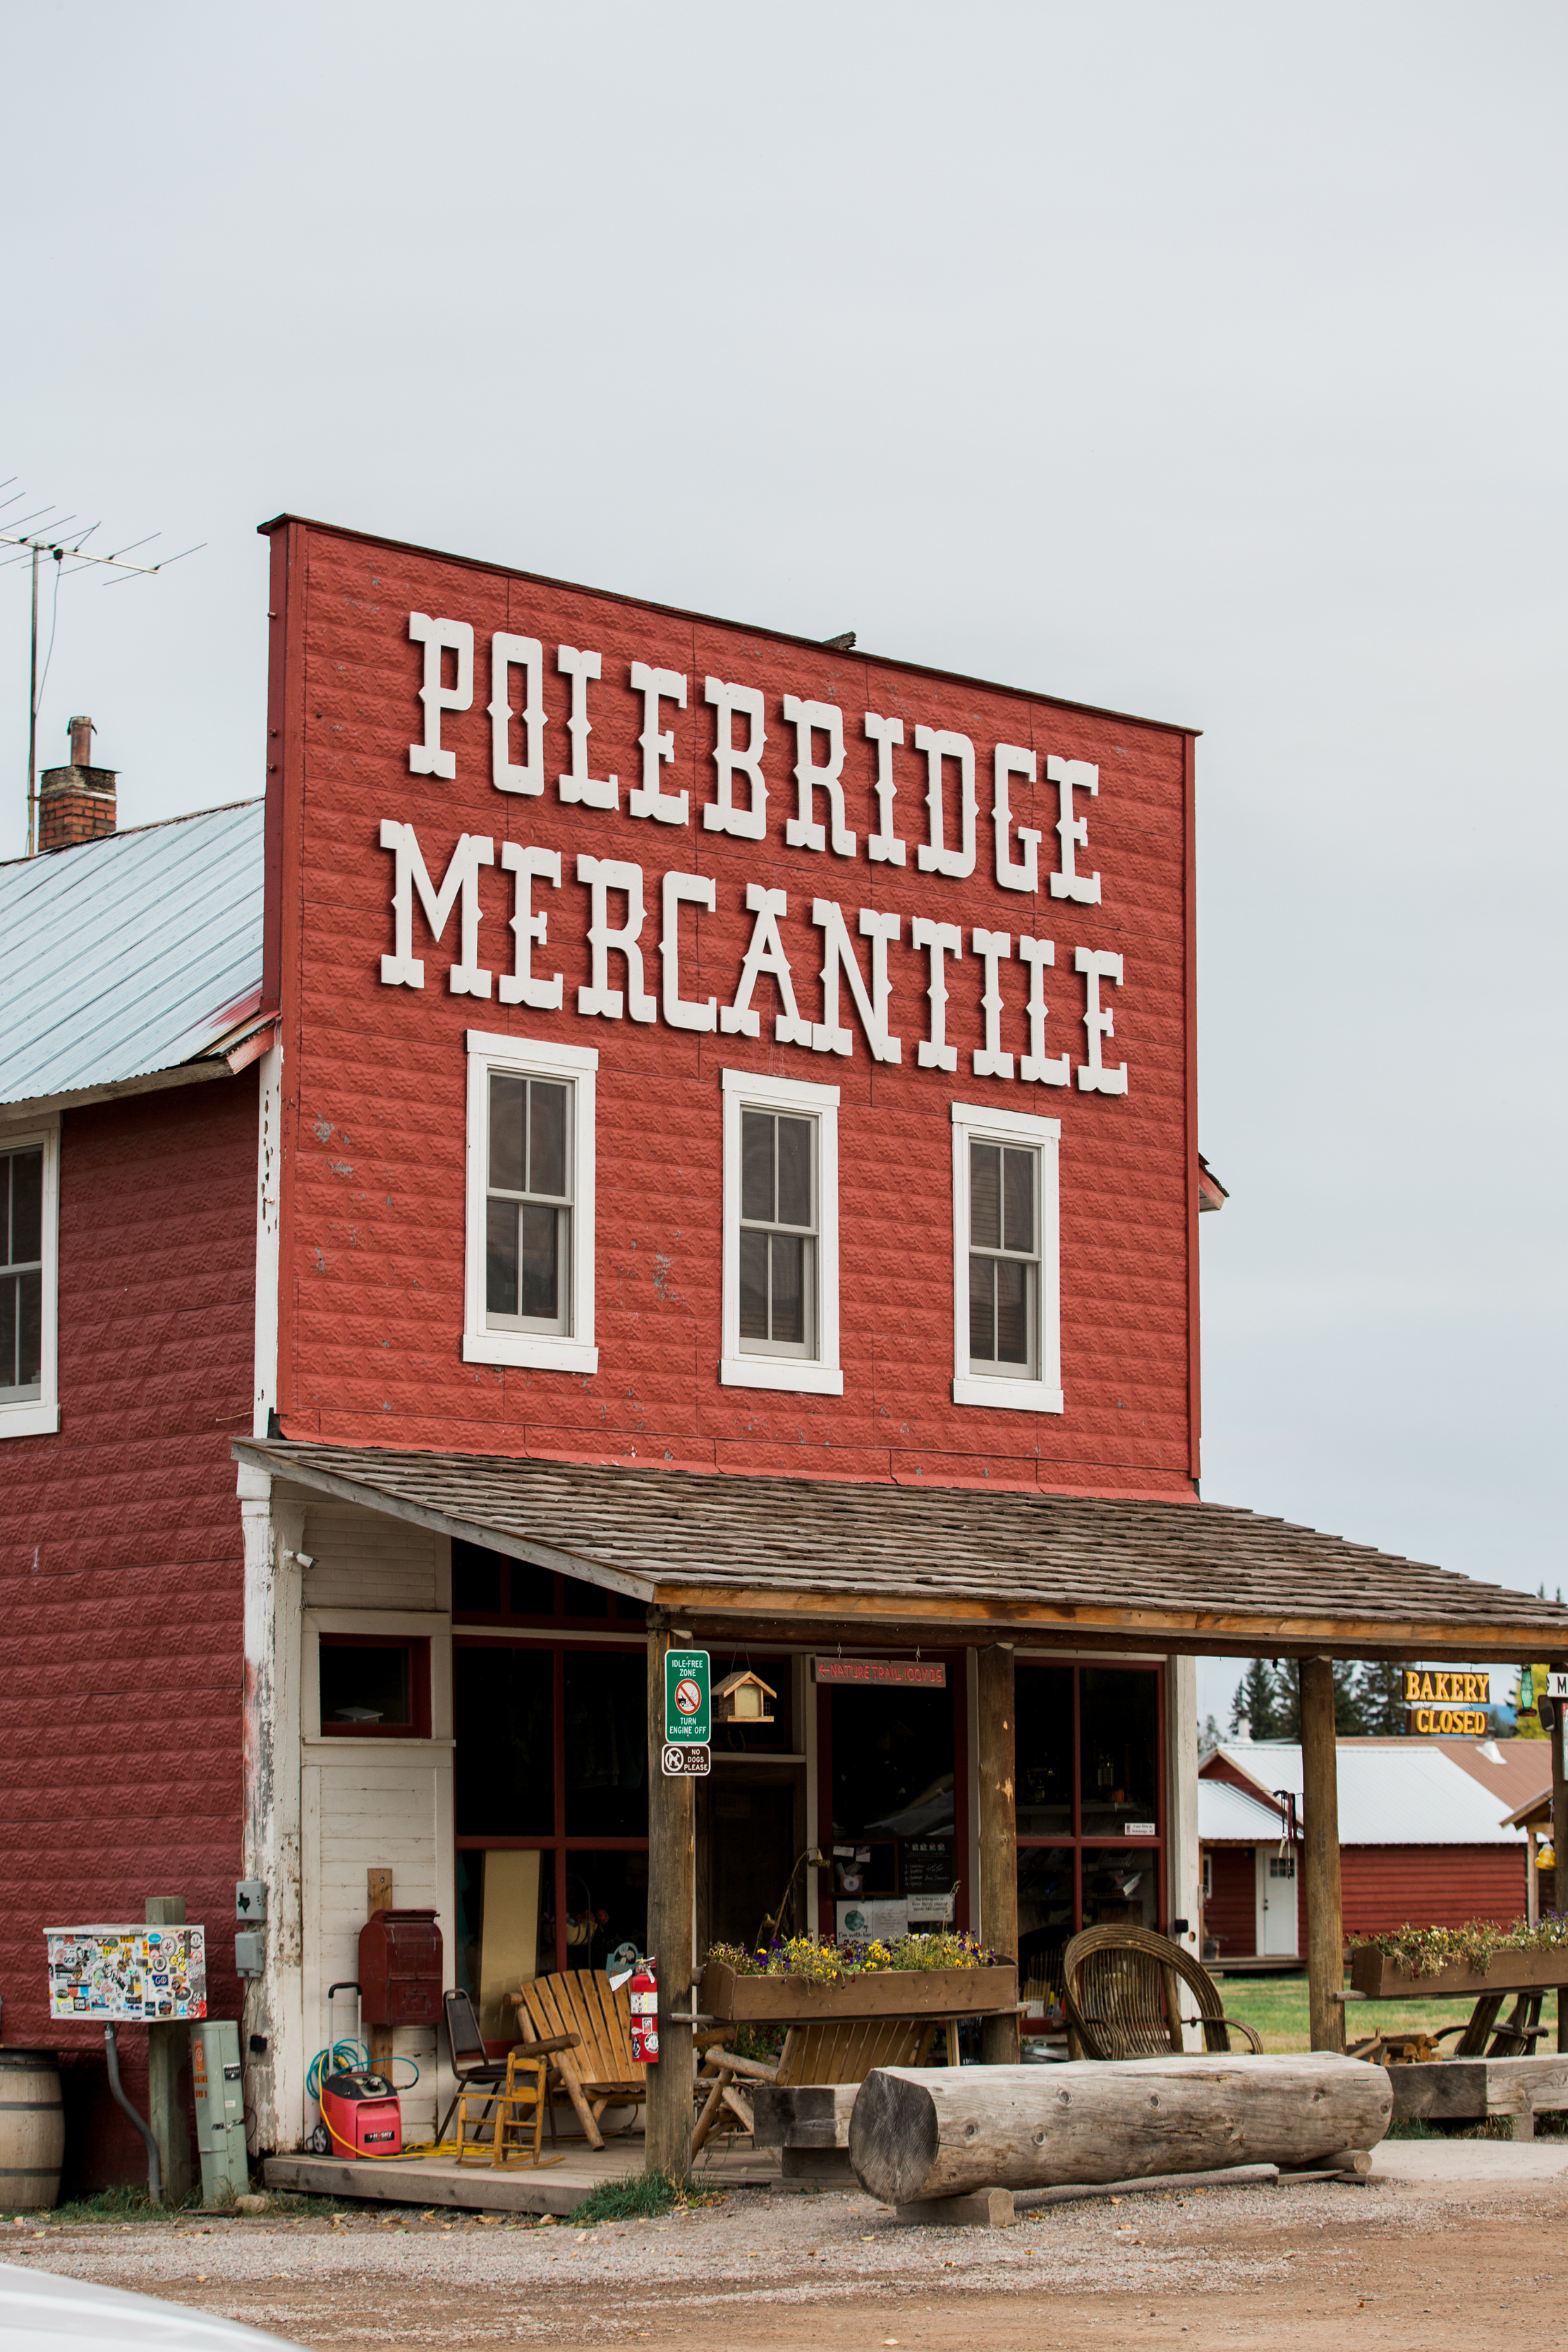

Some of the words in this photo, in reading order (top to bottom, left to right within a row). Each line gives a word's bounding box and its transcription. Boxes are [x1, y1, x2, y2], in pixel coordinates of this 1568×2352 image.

[409, 611, 1102, 905] POLEBRIDGE
[380, 818, 1128, 1096] MERCANTILE
[671, 1659, 703, 1668] IDLE-FREE
[679, 1668, 696, 1677] ZONE
[830, 1663, 870, 1680] NATURE
[871, 1666, 902, 1680] TRAIL
[1405, 1671, 1490, 1703] BAKERY
[669, 1726, 693, 1735] ENGINE
[694, 1726, 707, 1735] OFF
[1416, 1709, 1485, 1734] CLOSED
